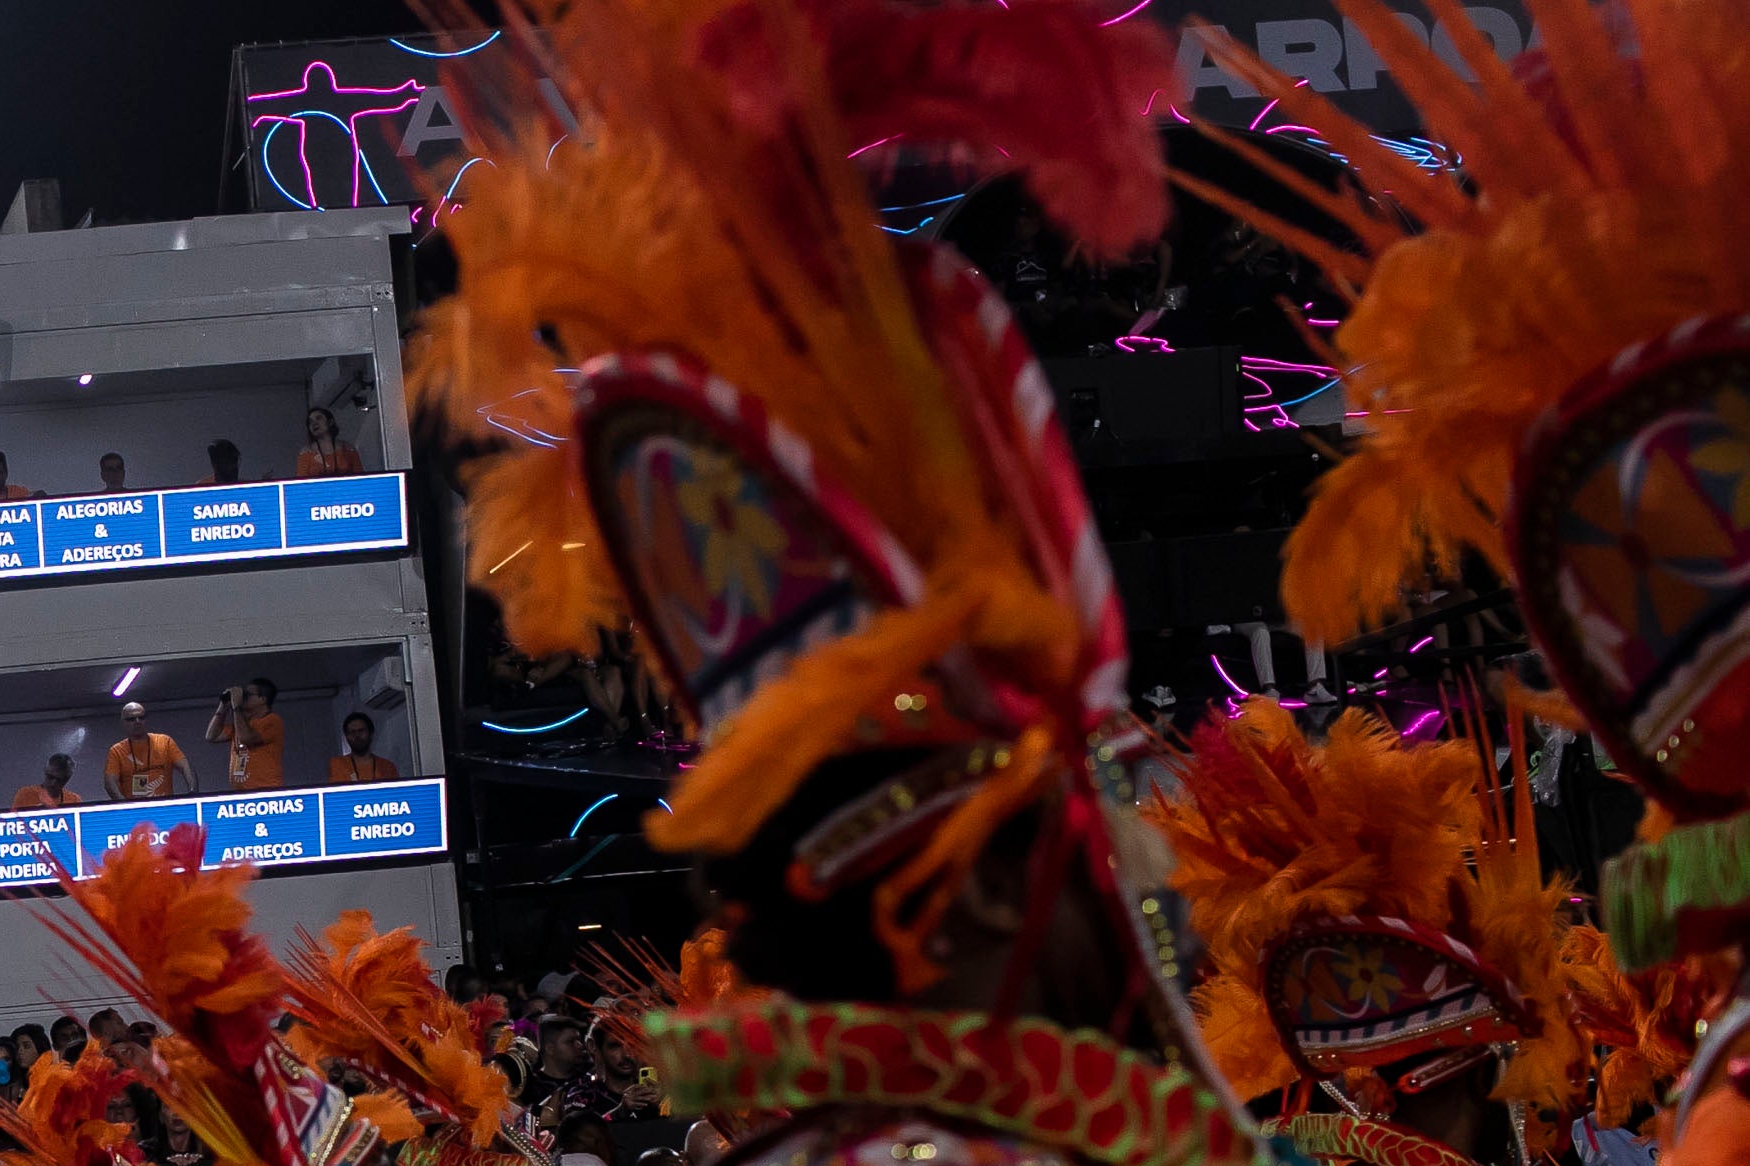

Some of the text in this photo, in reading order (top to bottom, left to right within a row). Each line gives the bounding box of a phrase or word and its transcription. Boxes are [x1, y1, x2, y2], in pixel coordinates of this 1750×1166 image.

[55, 500, 143, 519] ALEGORIAS
[194, 503, 250, 519] SAMBA
[311, 503, 374, 520] ENREDO
[95, 524, 108, 537] &
[191, 524, 254, 541] ENREDO
[62, 544, 143, 563] ADEREÇOS
[217, 798, 303, 818] ALEGORIAS
[354, 802, 410, 818] SAMBA
[28, 815, 68, 833] SALA
[255, 823, 268, 836] &
[352, 822, 414, 840] ENREDO
[107, 831, 170, 849] ENDO
[0, 841, 51, 857] PORTA
[222, 842, 302, 861] ADEREÇOS
